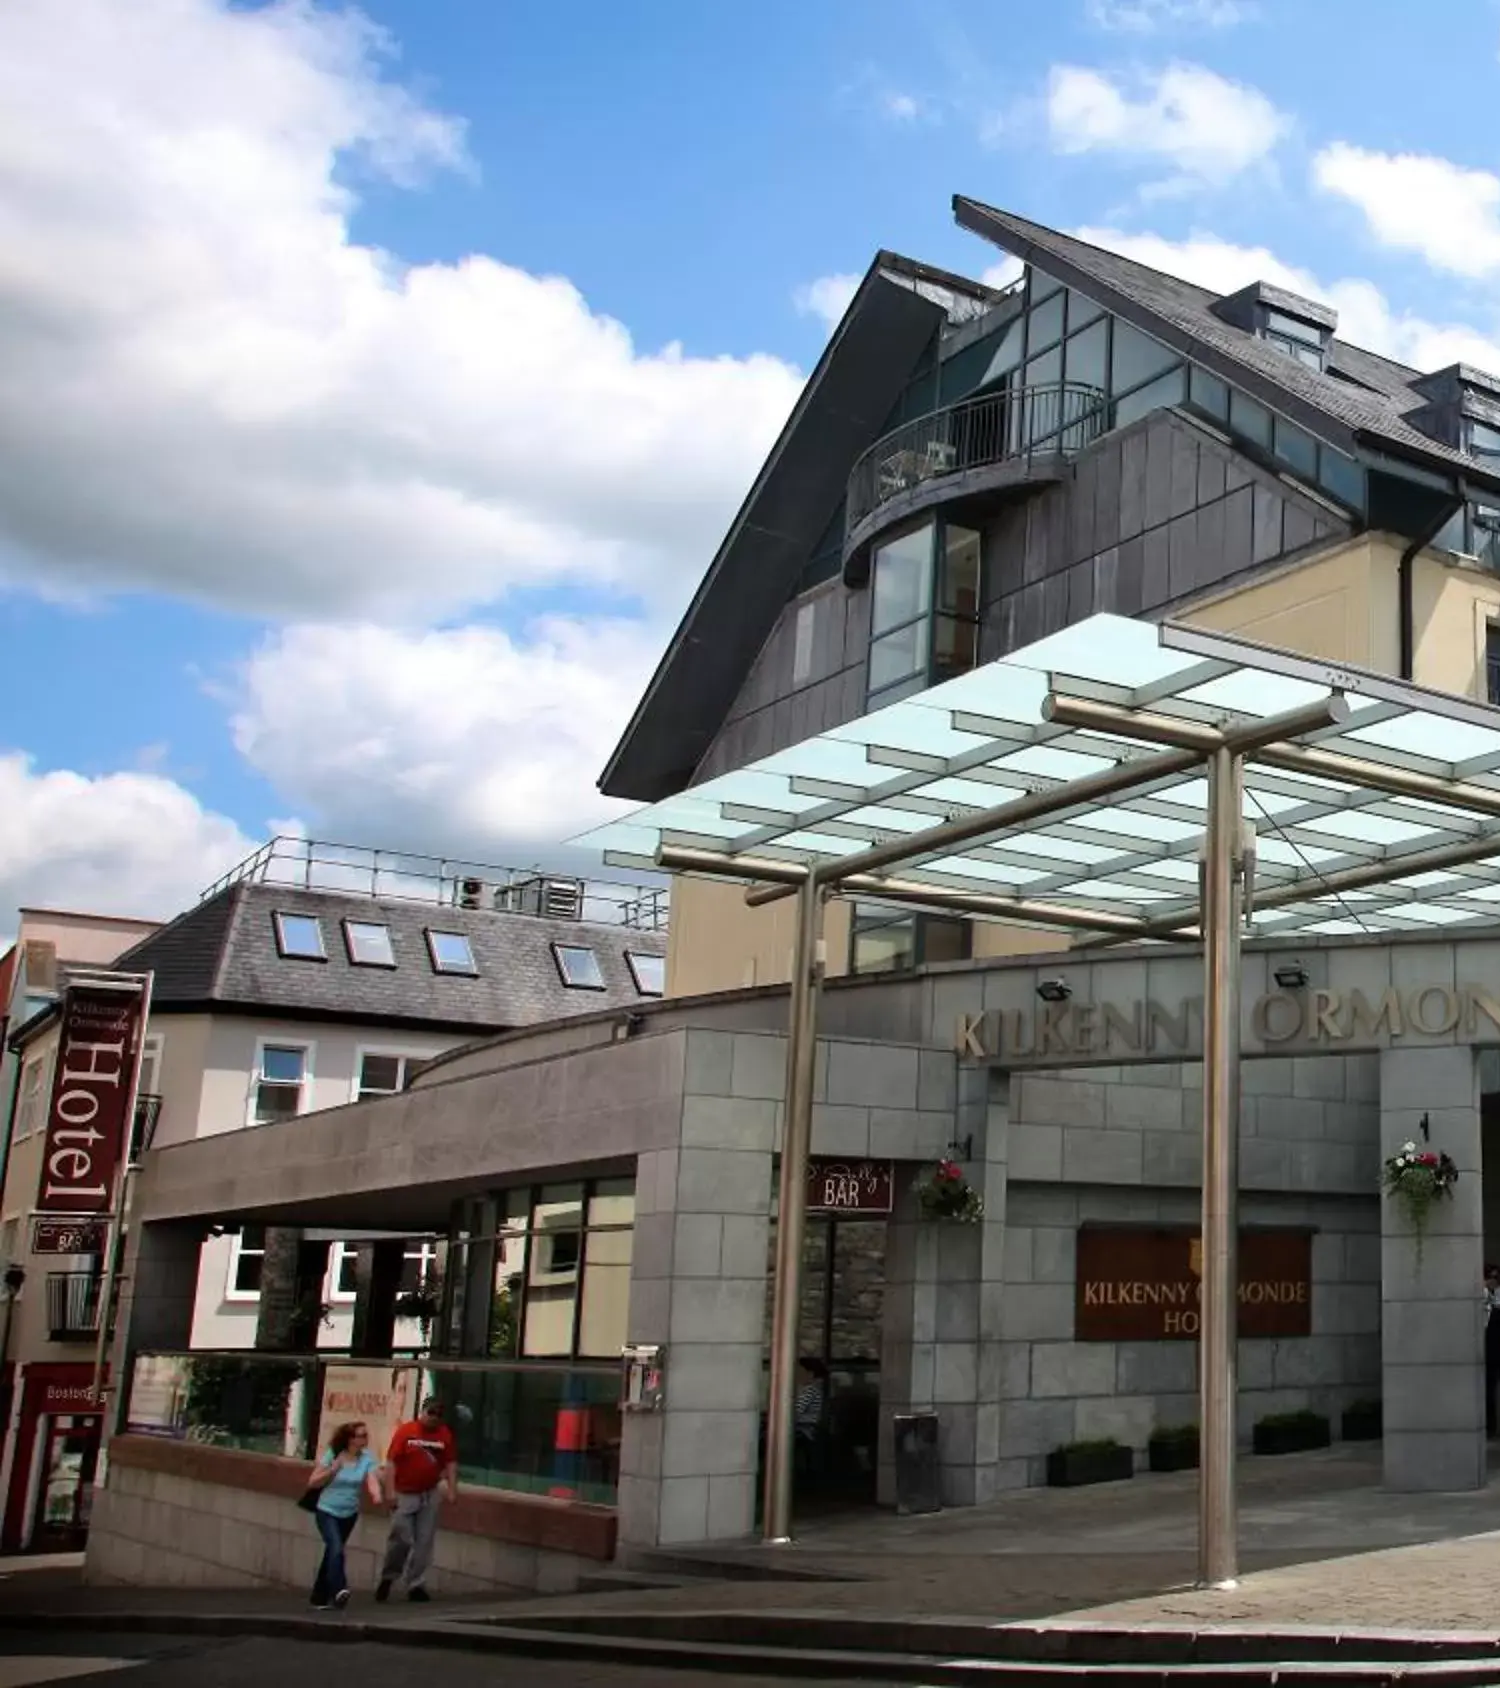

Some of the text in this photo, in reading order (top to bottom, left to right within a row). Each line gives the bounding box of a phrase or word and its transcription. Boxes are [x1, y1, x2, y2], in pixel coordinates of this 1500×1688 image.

[45, 1036, 125, 1199] Hotel
[823, 1179, 859, 1206] BAR
[1084, 1281, 1190, 1305] KILKENNY
